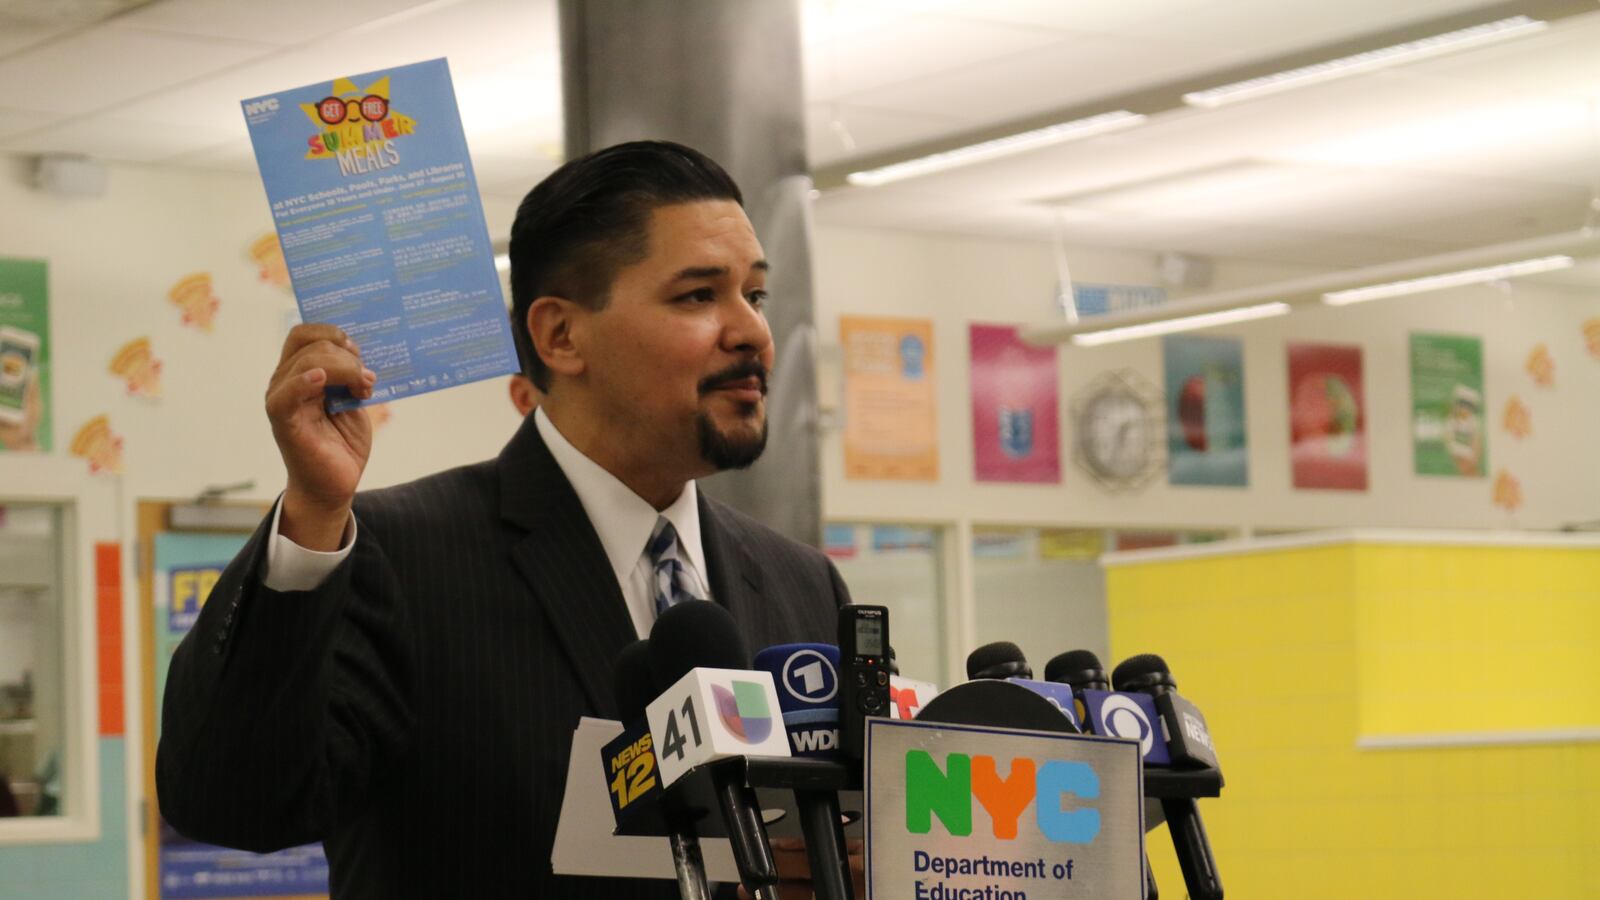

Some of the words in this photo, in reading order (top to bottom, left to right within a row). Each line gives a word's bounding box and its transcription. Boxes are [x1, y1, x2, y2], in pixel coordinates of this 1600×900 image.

[246, 99, 280, 115] NYC
[322, 102, 341, 118] GET
[362, 98, 386, 117] FREE
[308, 119, 413, 154] SUMMER
[336, 140, 400, 176] MEALS
[273, 201, 284, 209] at
[285, 196, 306, 207] NYC
[308, 187, 348, 202] Schools,
[407, 170, 425, 180] and
[426, 162, 464, 176] Libraries
[275, 210, 288, 218] For
[290, 201, 325, 215] Everyone
[358, 191, 372, 199] and
[662, 695, 702, 761] 41
[792, 729, 838, 752] WD
[612, 732, 653, 774] NEWS
[611, 751, 656, 809] 12
[906, 749, 1101, 844] NYC
[914, 851, 1046, 879] Department
[1052, 859, 1073, 880] of
[915, 880, 1026, 900] Education
